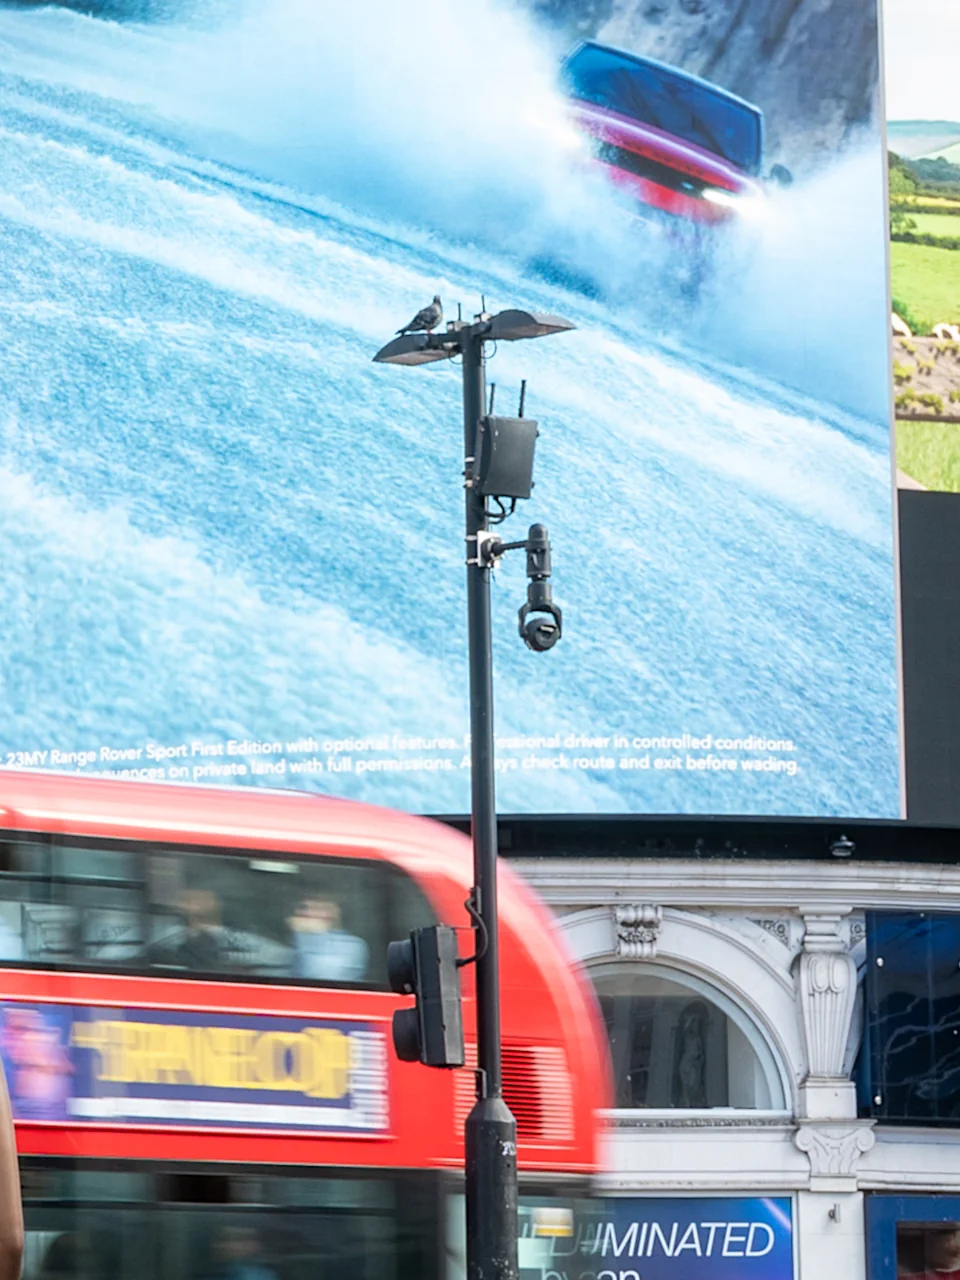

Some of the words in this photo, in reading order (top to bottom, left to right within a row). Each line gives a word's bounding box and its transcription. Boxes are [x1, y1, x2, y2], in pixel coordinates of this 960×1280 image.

[50, 748, 97, 767] Range
[100, 746, 143, 762] Rover
[146, 743, 188, 761] Sport
[191, 739, 224, 756] First
[227, 738, 282, 756] Edition
[286, 736, 319, 753] with
[324, 734, 388, 754] optional
[391, 733, 460, 751] features.
[563, 733, 610, 749] driver
[614, 734, 628, 749] in
[632, 734, 711, 750] controlled
[714, 736, 797, 752] conditions.
[169, 765, 189, 778] on
[193, 761, 247, 780] private
[251, 758, 285, 775] land
[290, 757, 323, 774] with
[326, 755, 352, 773] full
[355, 754, 456, 776] permissions.
[522, 753, 569, 770] check
[572, 755, 616, 770] route
[619, 753, 651, 770] and
[654, 754, 683, 771] exit
[686, 754, 738, 771] before
[741, 757, 801, 775] wading.
